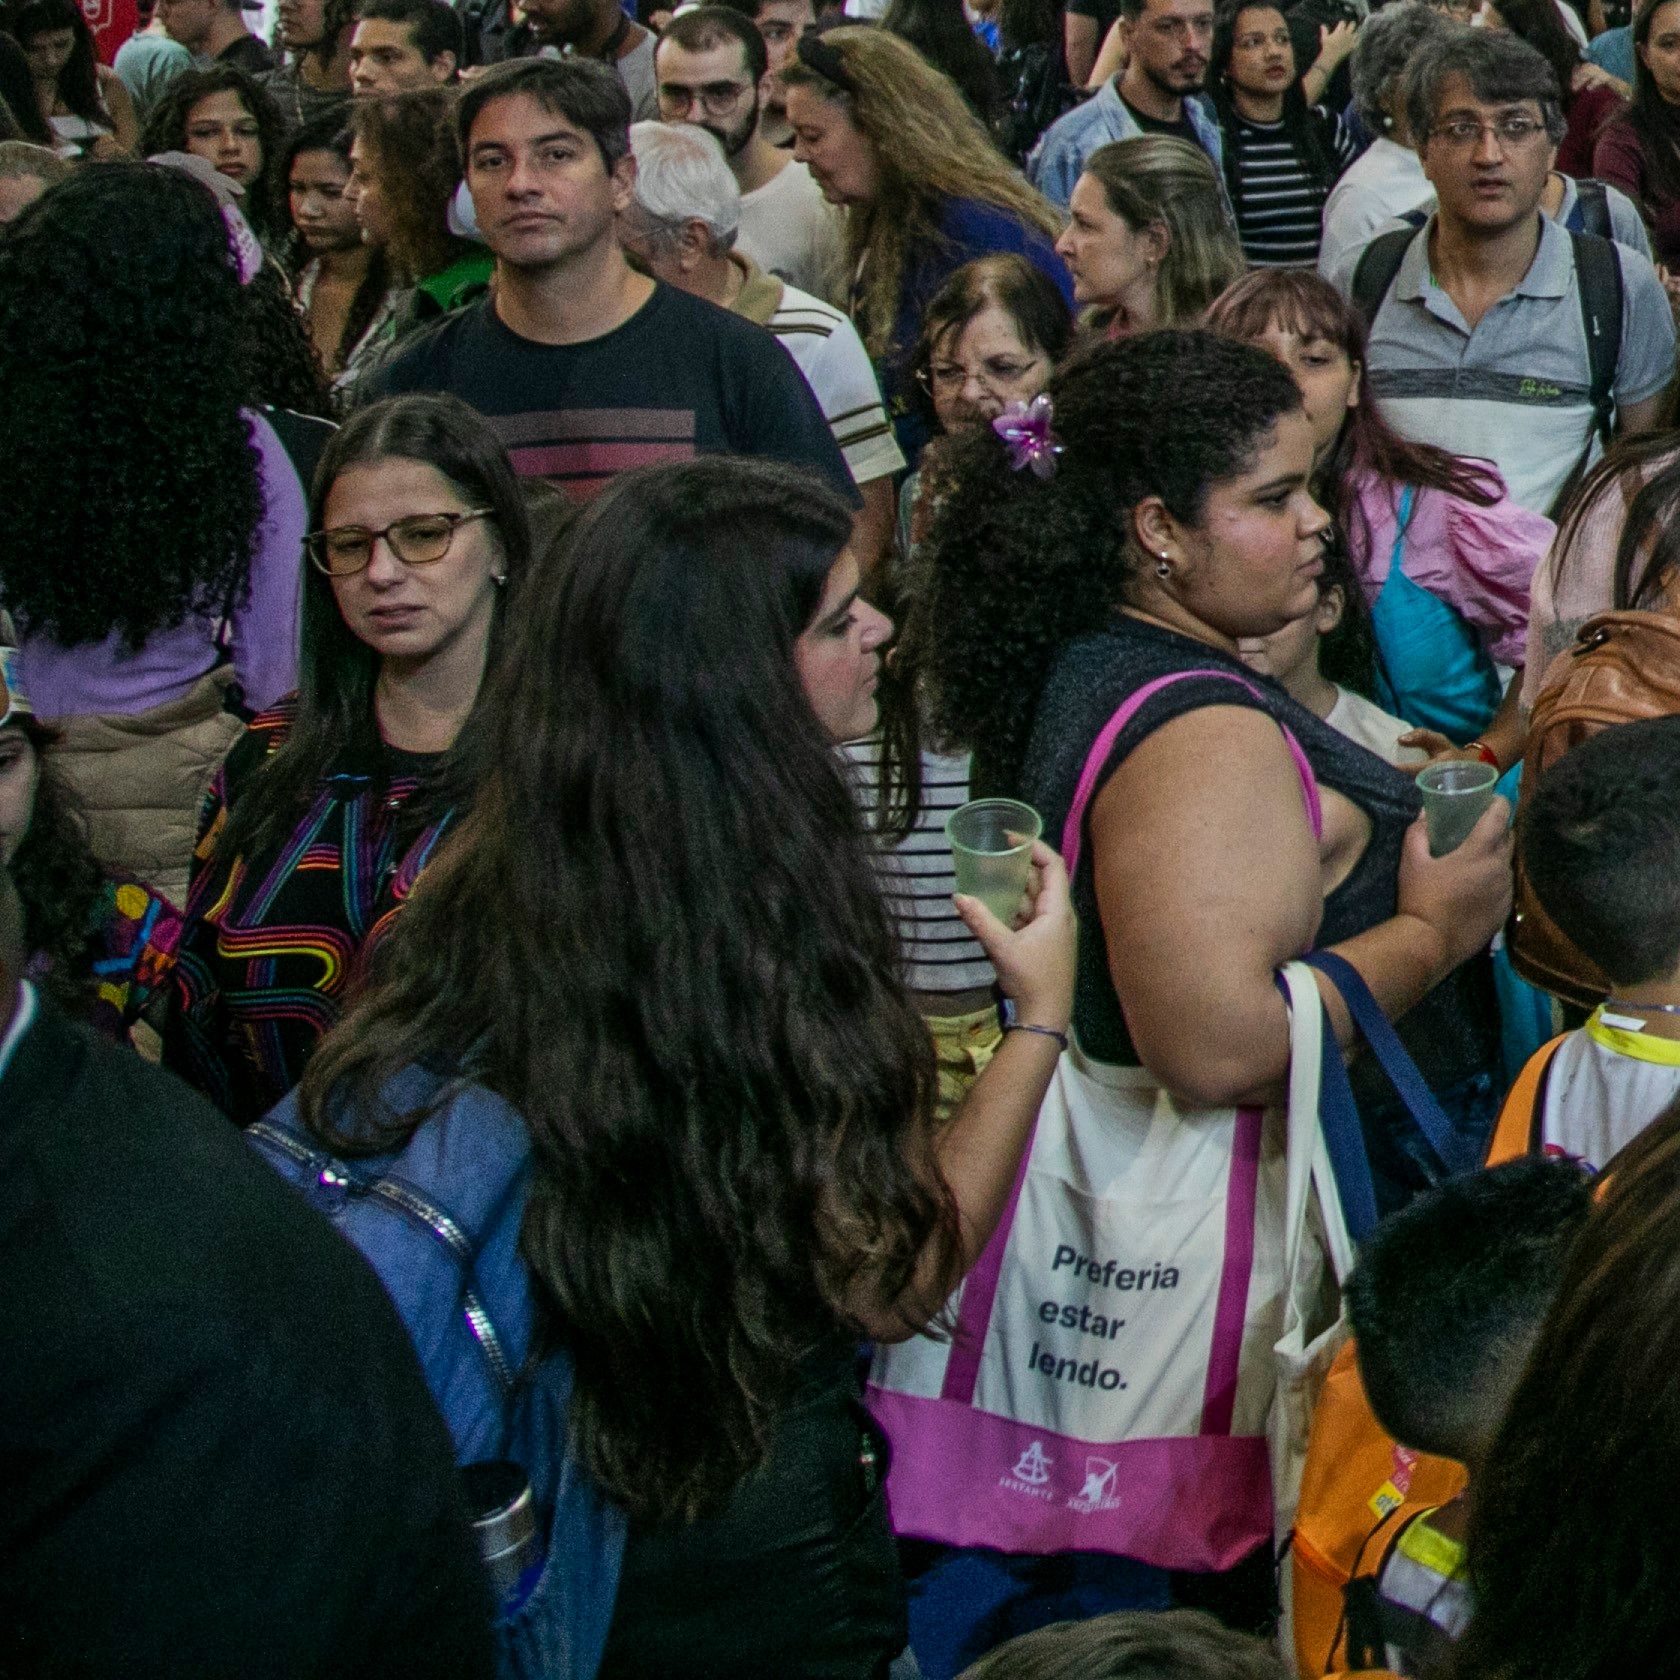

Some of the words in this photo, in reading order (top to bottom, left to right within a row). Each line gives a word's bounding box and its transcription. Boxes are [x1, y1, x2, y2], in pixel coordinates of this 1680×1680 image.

[1052, 1244, 1180, 1292] Preferia
[1039, 1298, 1125, 1341] estar
[1028, 1343, 1128, 1391] lendo.
